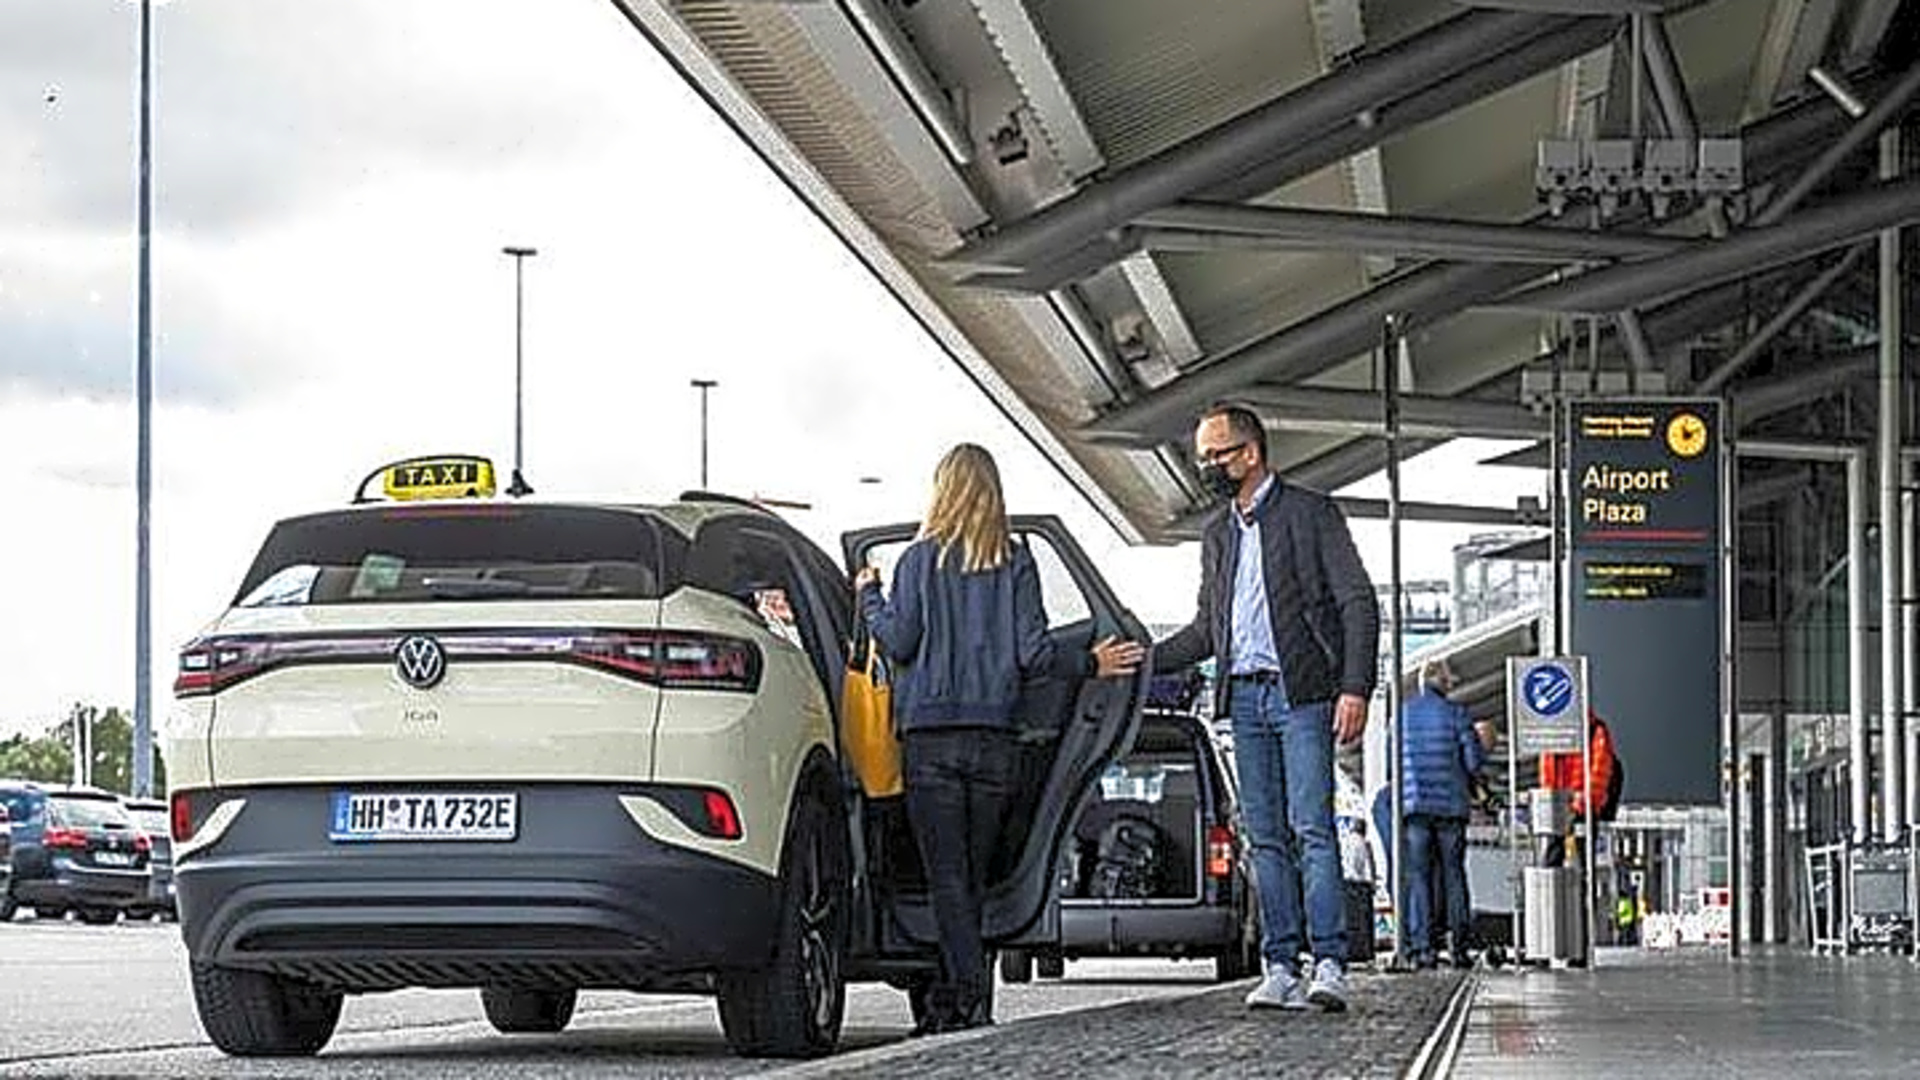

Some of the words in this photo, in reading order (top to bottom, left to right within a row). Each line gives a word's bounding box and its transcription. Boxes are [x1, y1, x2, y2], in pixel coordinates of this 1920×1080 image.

[406, 466, 468, 484] TAXI
[1583, 465, 1670, 493] Airport
[1583, 499, 1645, 522] Plaza
[399, 636, 441, 682] VW
[351, 799, 385, 829] HH
[445, 799, 512, 829] 732E
